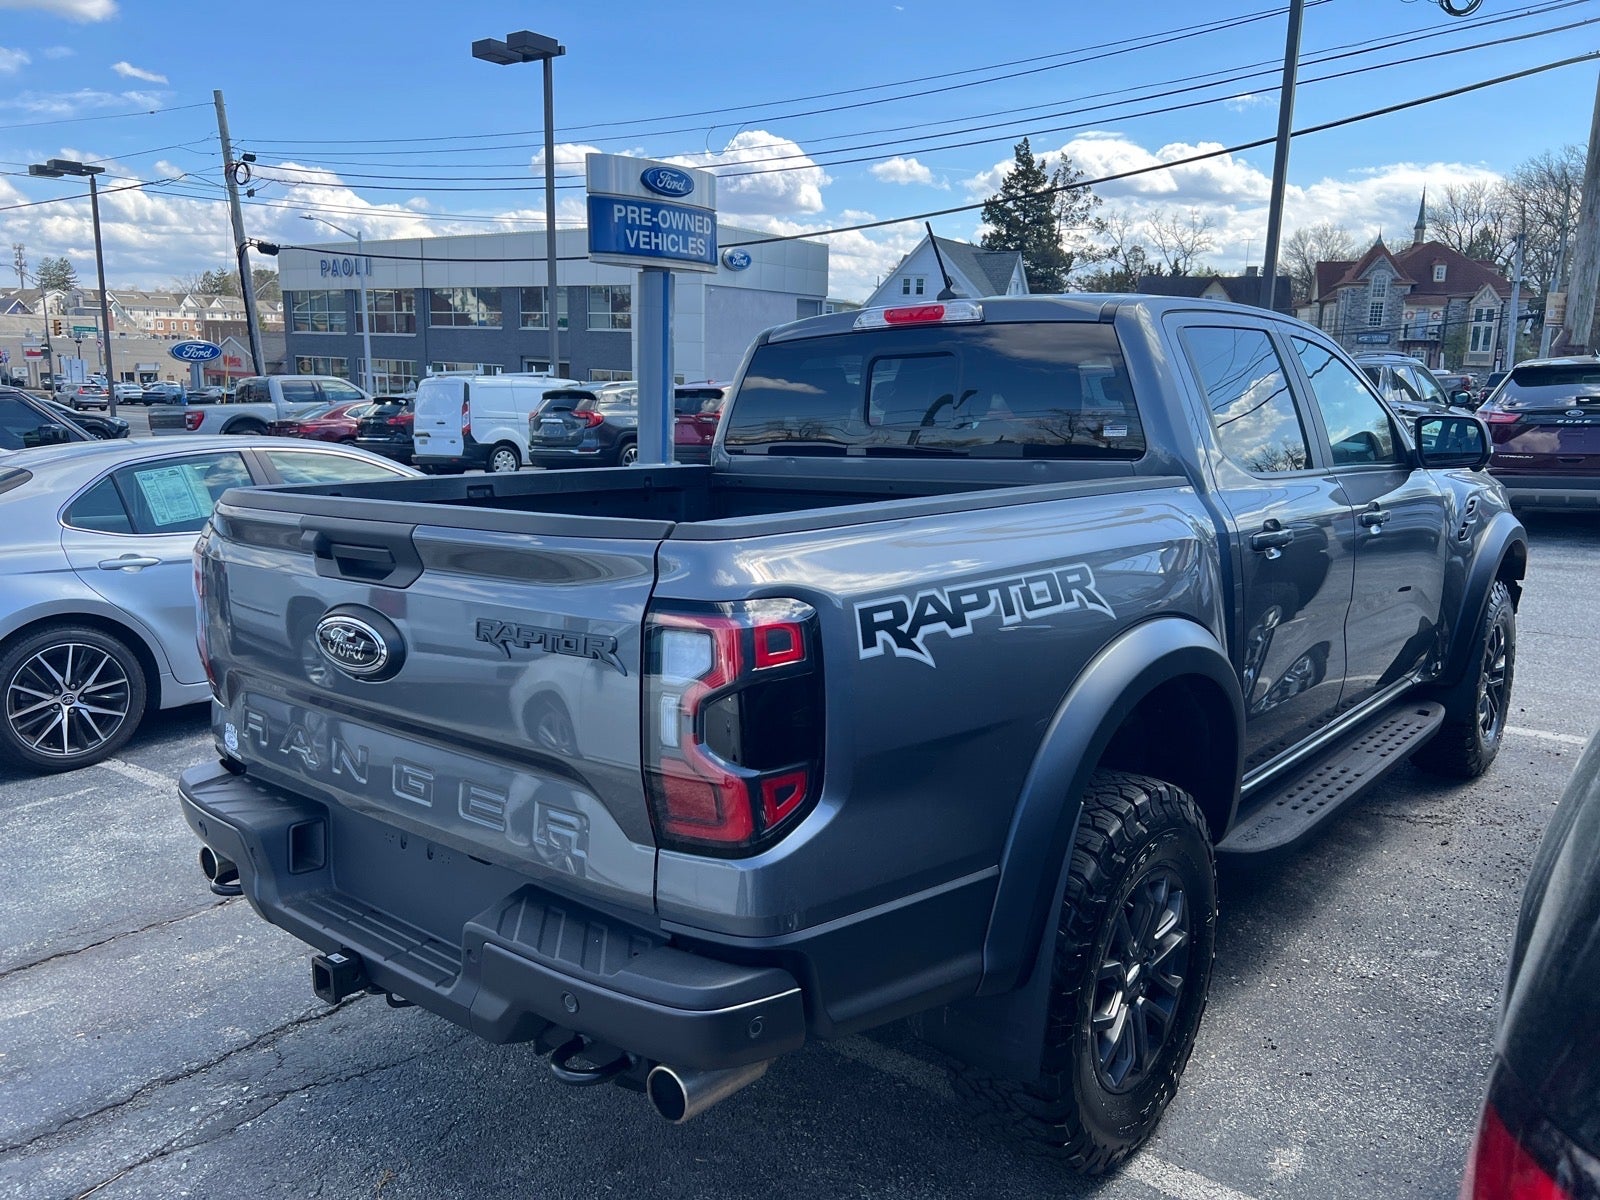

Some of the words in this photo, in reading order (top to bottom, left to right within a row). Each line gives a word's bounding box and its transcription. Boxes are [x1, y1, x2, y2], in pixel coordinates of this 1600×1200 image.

[656, 170, 686, 191] Ford
[613, 204, 712, 235] PRE-OWNED
[626, 229, 706, 257] VEHICLES
[320, 257, 371, 277] PAOLI
[182, 344, 213, 358] Ford
[853, 562, 1118, 669] RAPTOR
[327, 627, 365, 661] Ford
[475, 617, 628, 678] RAPTOR
[242, 707, 592, 879] RANGER
